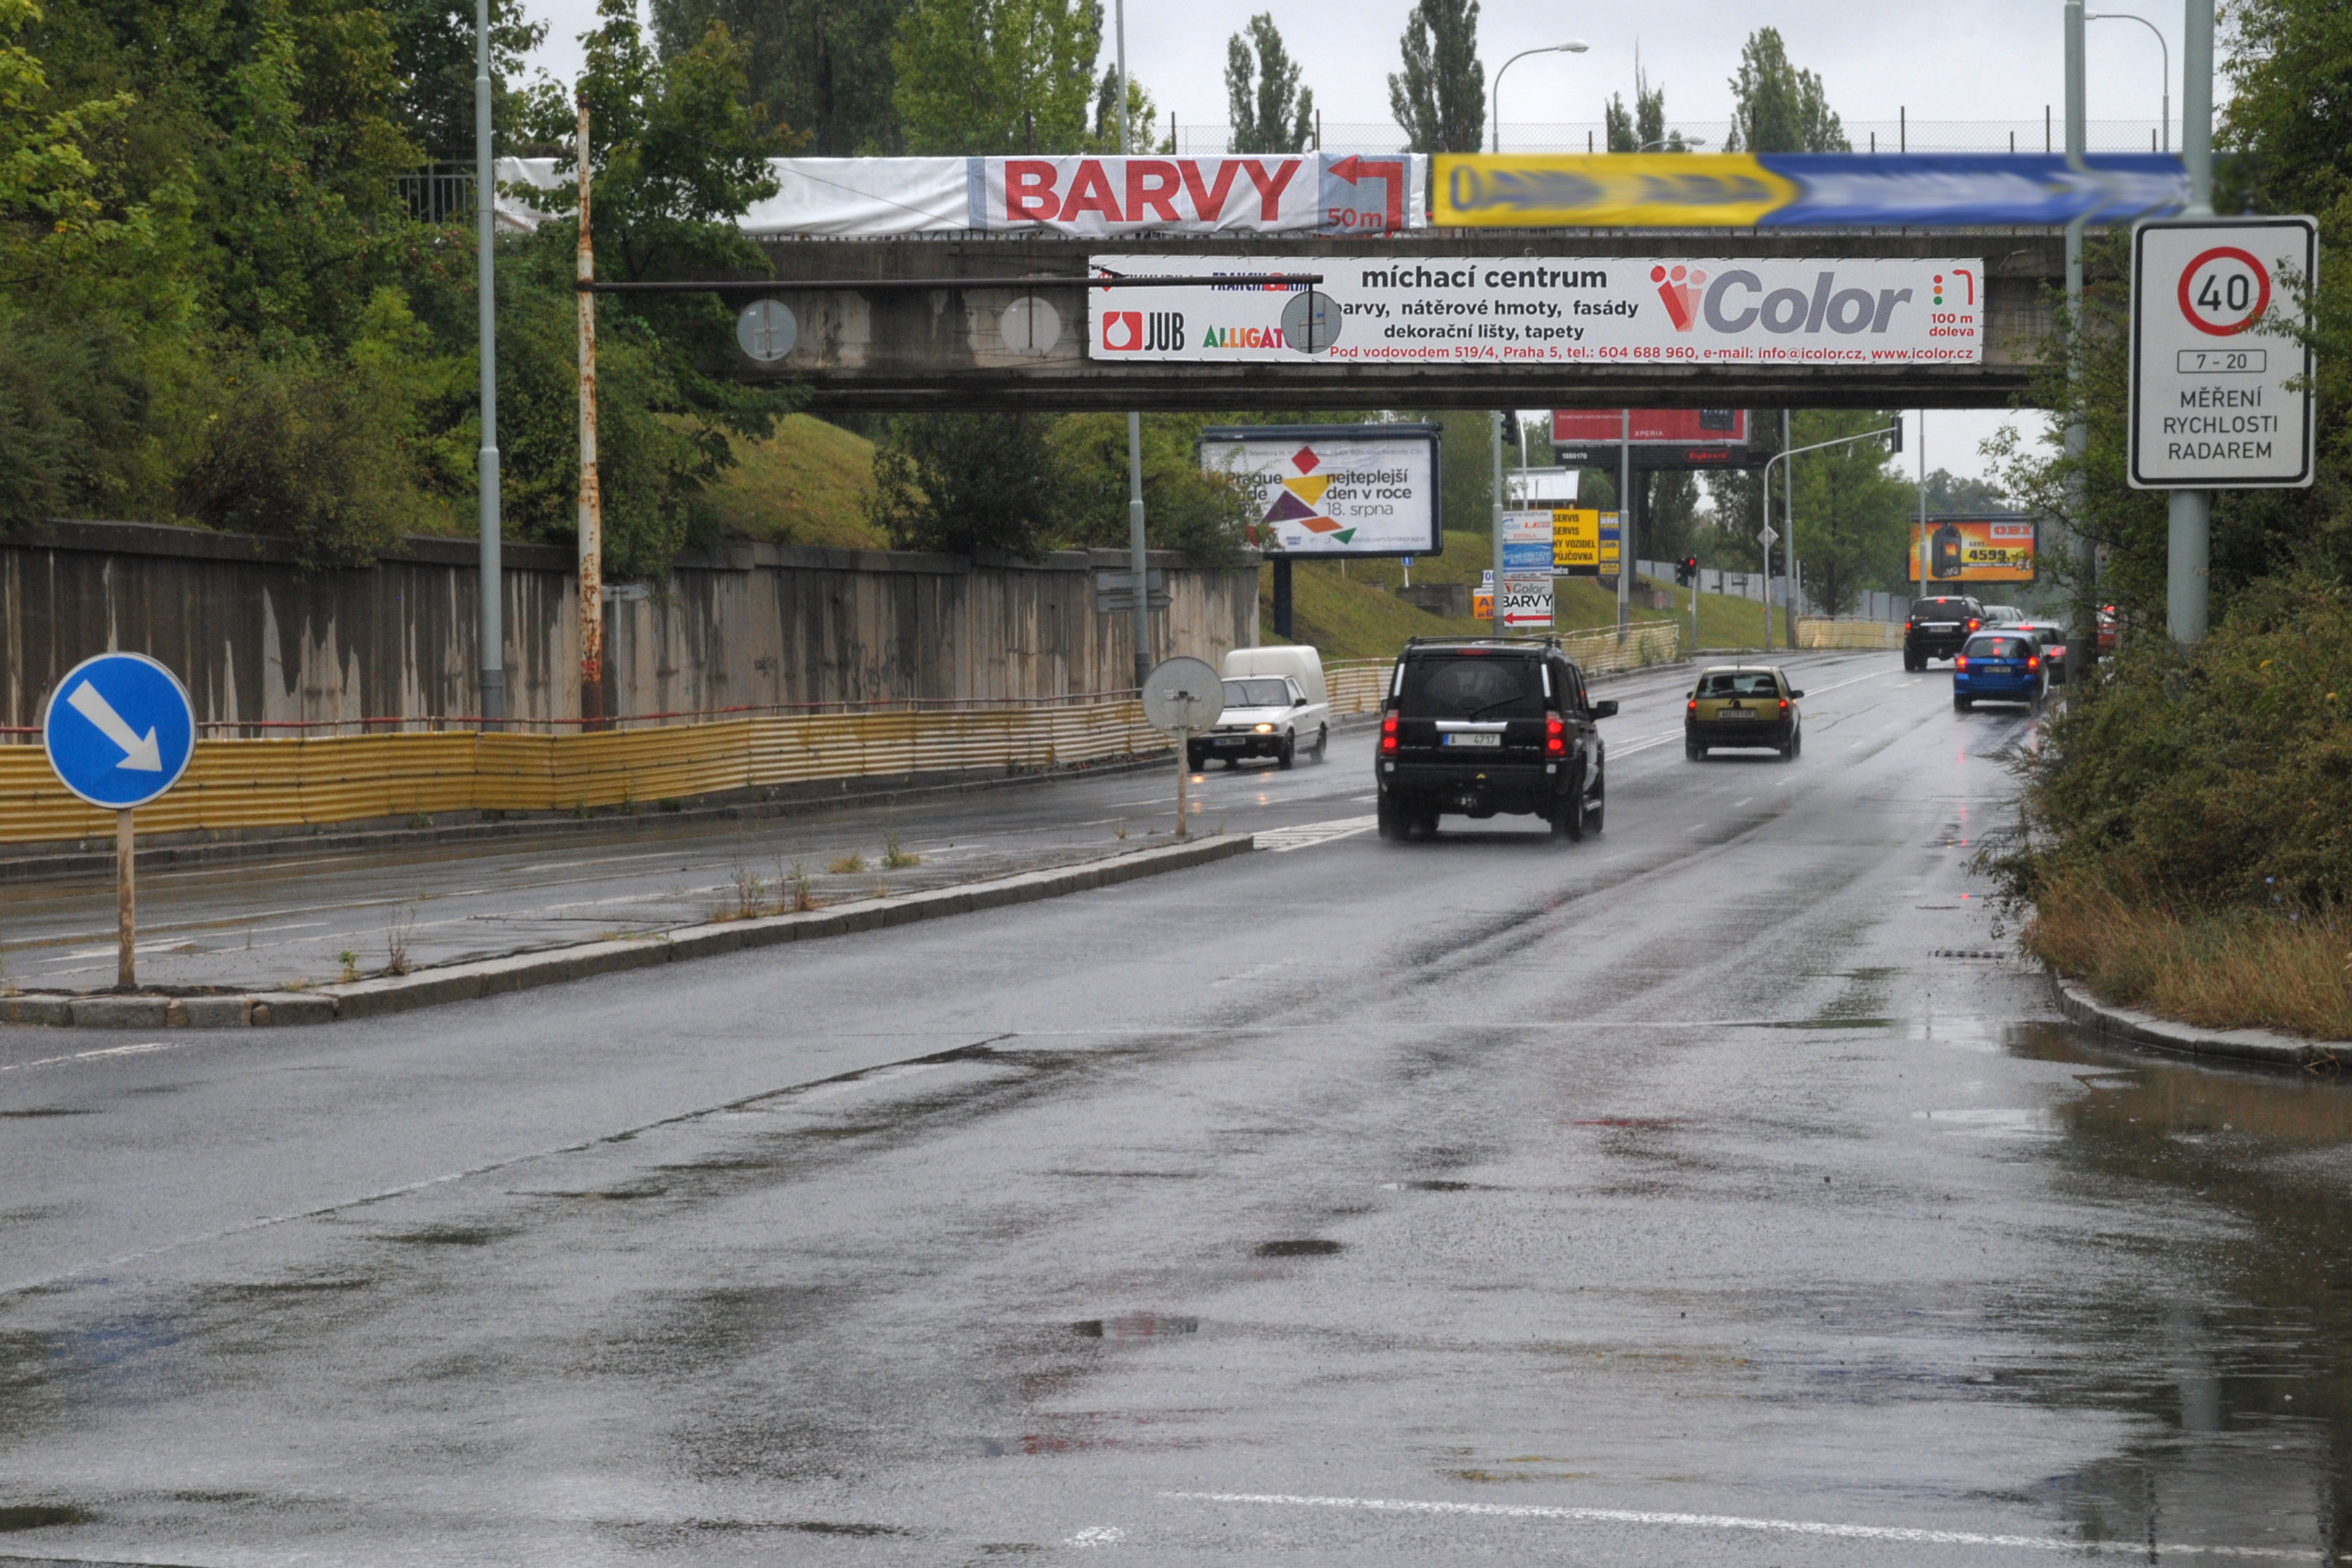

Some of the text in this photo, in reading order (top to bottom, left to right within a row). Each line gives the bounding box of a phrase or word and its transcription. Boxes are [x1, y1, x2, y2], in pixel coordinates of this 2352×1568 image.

[1005, 159, 1303, 222] BARVY
[1362, 264, 1607, 288] míchací centrum
[2197, 274, 2250, 311] 40
[1401, 299, 1488, 315] nátěrové
[1494, 300, 1562, 318] hmoty,
[1573, 300, 1639, 318] fasády
[1931, 313, 1973, 324] 100 m
[1144, 312, 1185, 351] JUB
[1383, 324, 1585, 341] dekorační lišty, tapety
[1929, 325, 1974, 337] doleva
[1330, 345, 1974, 361] Pod vodovodem 519/4, Praha 5, tel.: 604 688 960, e-mail: info@icolor.cz, www.icolor.cz
[2196, 354, 2207, 369] 7
[2227, 353, 2247, 369] 20
[2180, 386, 2263, 408] MĚŘENÍ
[2163, 416, 2278, 434] RYCHLOSTI
[2168, 441, 2272, 460] RADAREM
[1326, 469, 1409, 486] nejteplejší
[1326, 486, 1412, 499] den v roce
[1326, 502, 1394, 518] 18. srpna
[1994, 525, 2031, 535] OBI
[1565, 539, 1596, 548] VOZIDEL
[1503, 595, 1552, 607] BARVY
